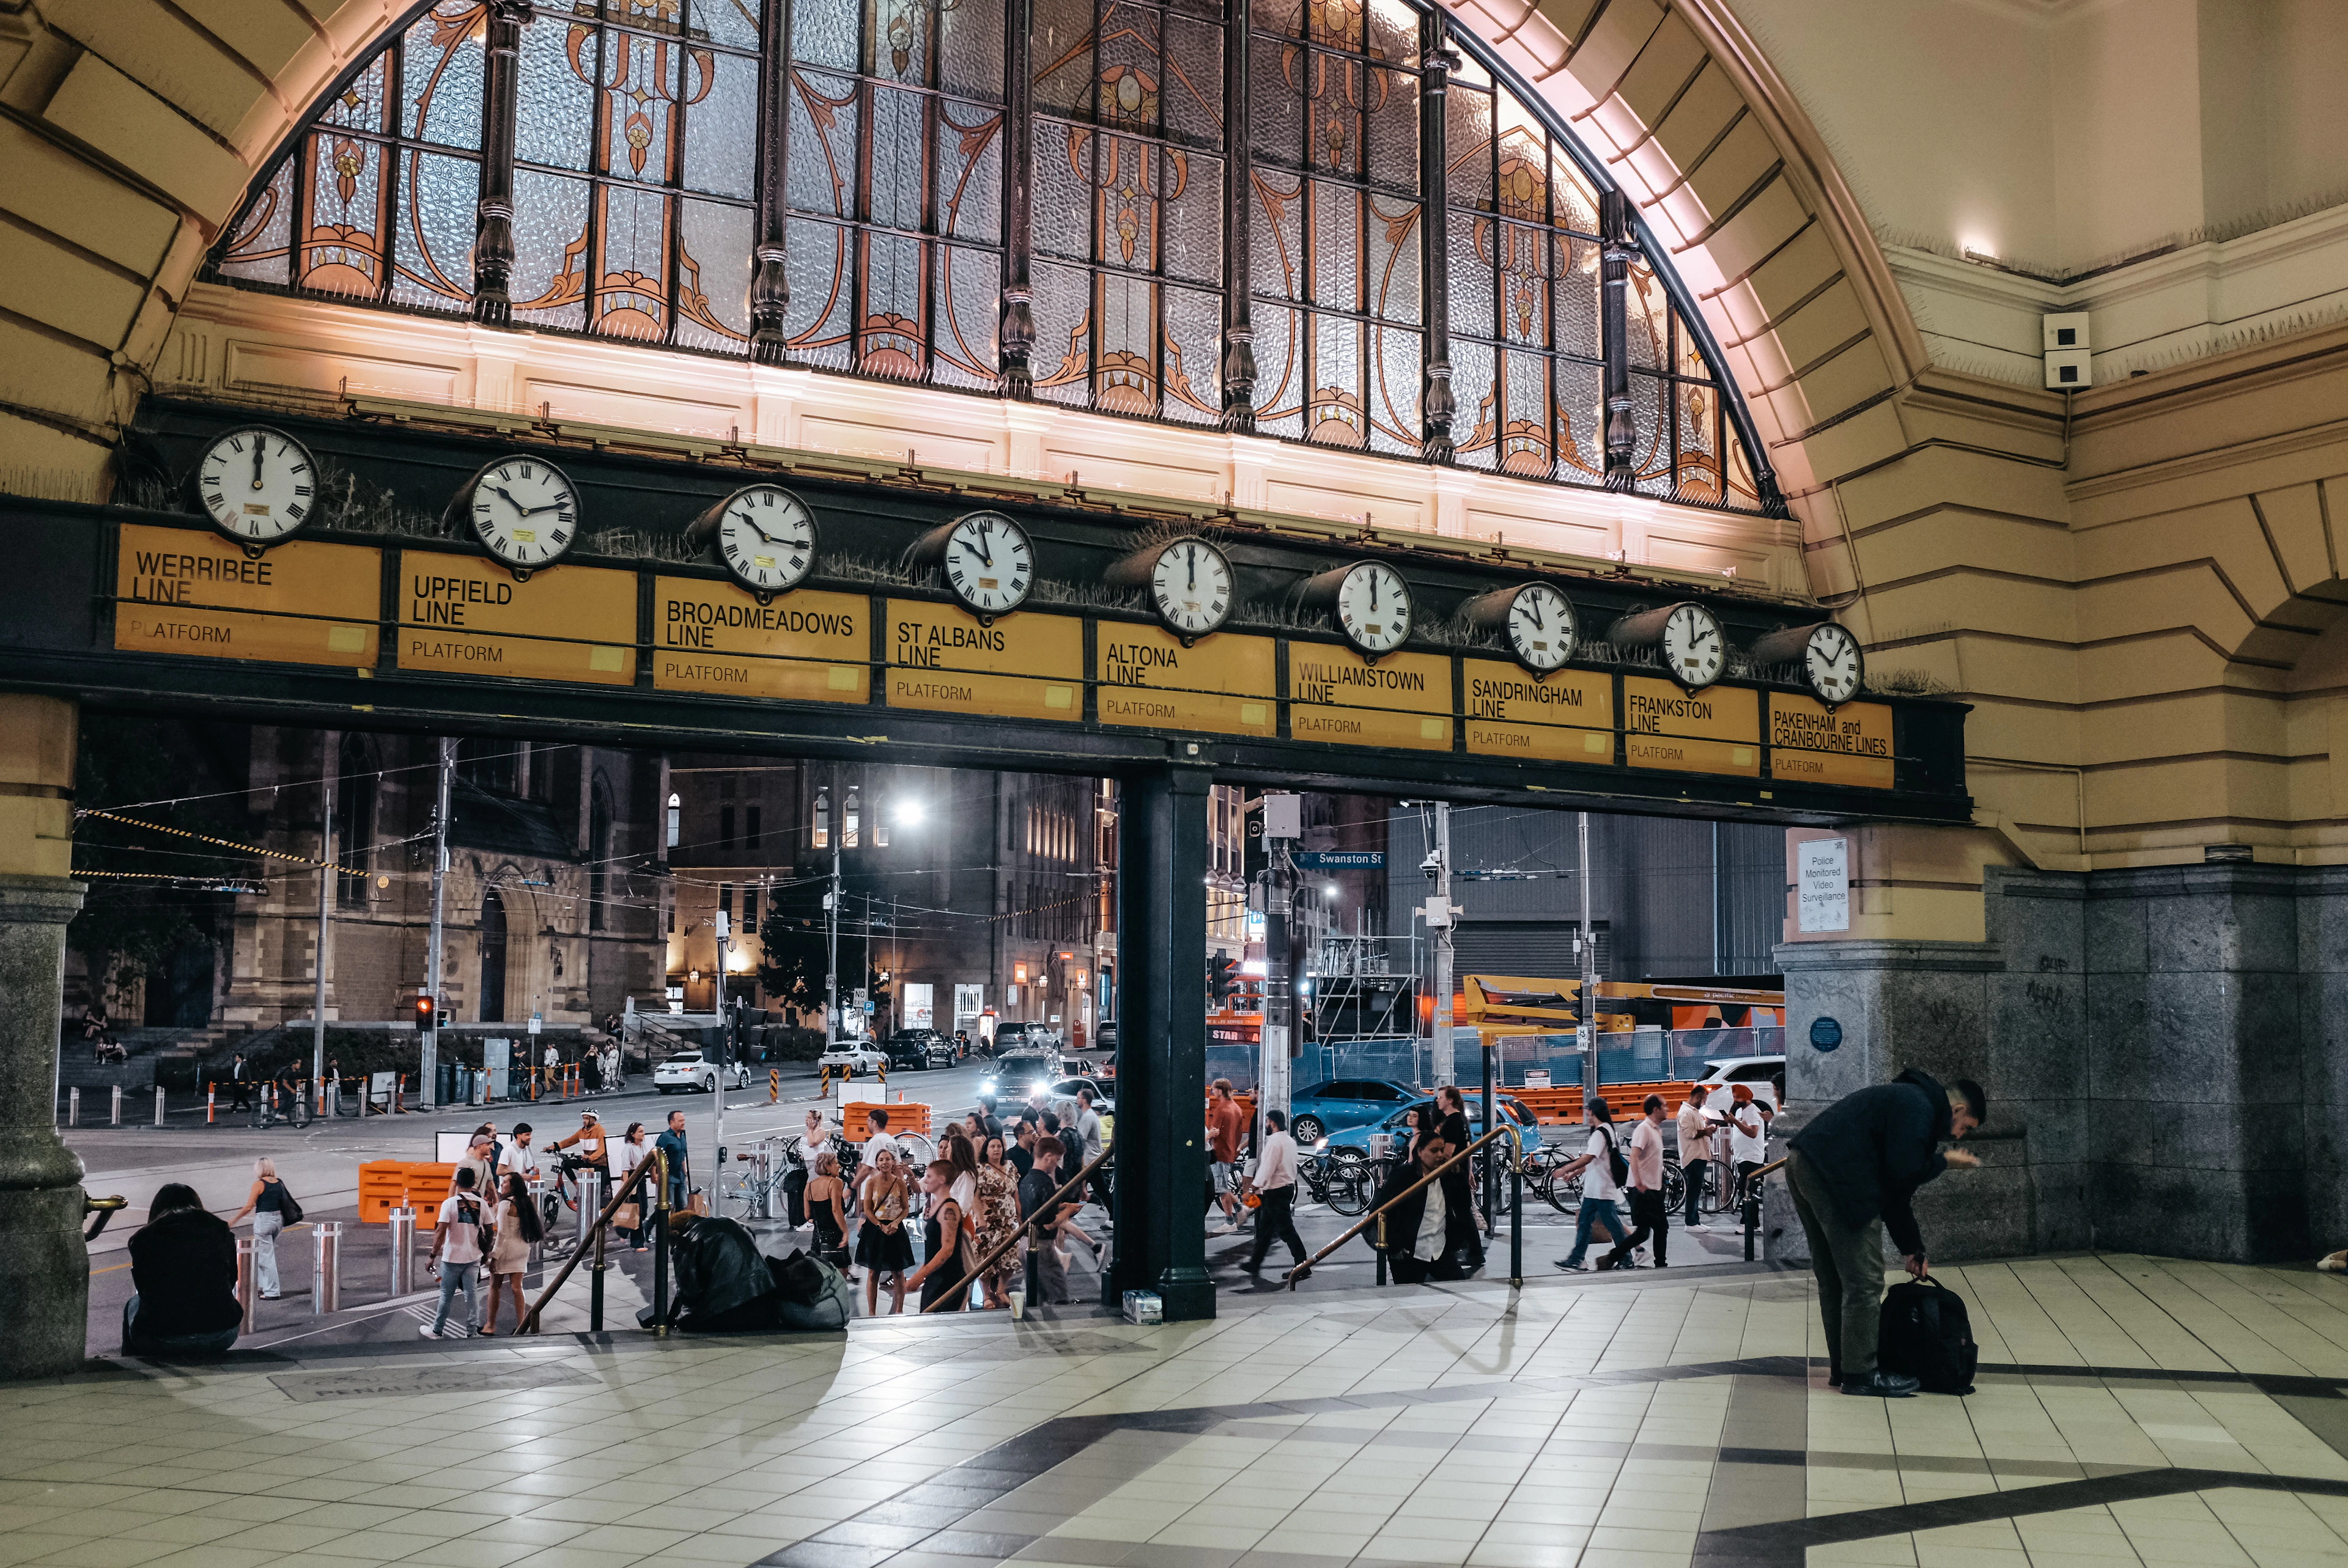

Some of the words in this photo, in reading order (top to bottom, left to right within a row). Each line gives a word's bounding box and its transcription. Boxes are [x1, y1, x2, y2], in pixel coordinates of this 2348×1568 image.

[295, 485, 310, 496] III
[558, 512, 572, 523] III
[136, 551, 272, 586] WERRIBEE
[133, 576, 192, 604] LINE
[415, 575, 512, 605] UPFIELD
[413, 599, 465, 625] LINE
[667, 600, 853, 636] BROADMEADOWS
[131, 620, 231, 642] PLATFORM
[666, 624, 714, 648] LINE
[898, 622, 922, 643] ST
[928, 625, 1005, 651] ALBANS
[412, 641, 503, 662] PLATFORM
[898, 644, 940, 667] LINE
[1107, 643, 1178, 668] ALTONA
[666, 663, 748, 683] PLATFORM
[1107, 664, 1145, 685] LINE
[1299, 662, 1424, 691] WILLIAMSTOWN
[897, 682, 972, 701] PLATFORM
[1299, 683, 1334, 703] LINE
[1472, 679, 1582, 706] SANDRINGHAM
[1107, 700, 1175, 718] PLATFORM
[1472, 699, 1505, 718] LINE
[1630, 695, 1711, 720] FRANKSTON
[1299, 717, 1360, 733] PLATFORM
[1631, 713, 1660, 732] LINE
[1774, 711, 1835, 732] PAKENHAM
[1842, 720, 1860, 735] and
[1474, 731, 1530, 747] PLATFORM
[1775, 728, 1853, 751] CRANBOURNE
[1856, 737, 1886, 754] LINES
[1631, 745, 1683, 760] PLATFORM
[1776, 759, 1823, 773] PLATFORM
[1320, 853, 1368, 863] Swanston
[1371, 853, 1381, 863] St
[1812, 857, 1834, 866] Police
[1806, 867, 1840, 878] Monitored
[1813, 881, 1833, 889] Video
[1803, 893, 1845, 902] Surveillance
[1213, 1029, 1238, 1040] STAR
